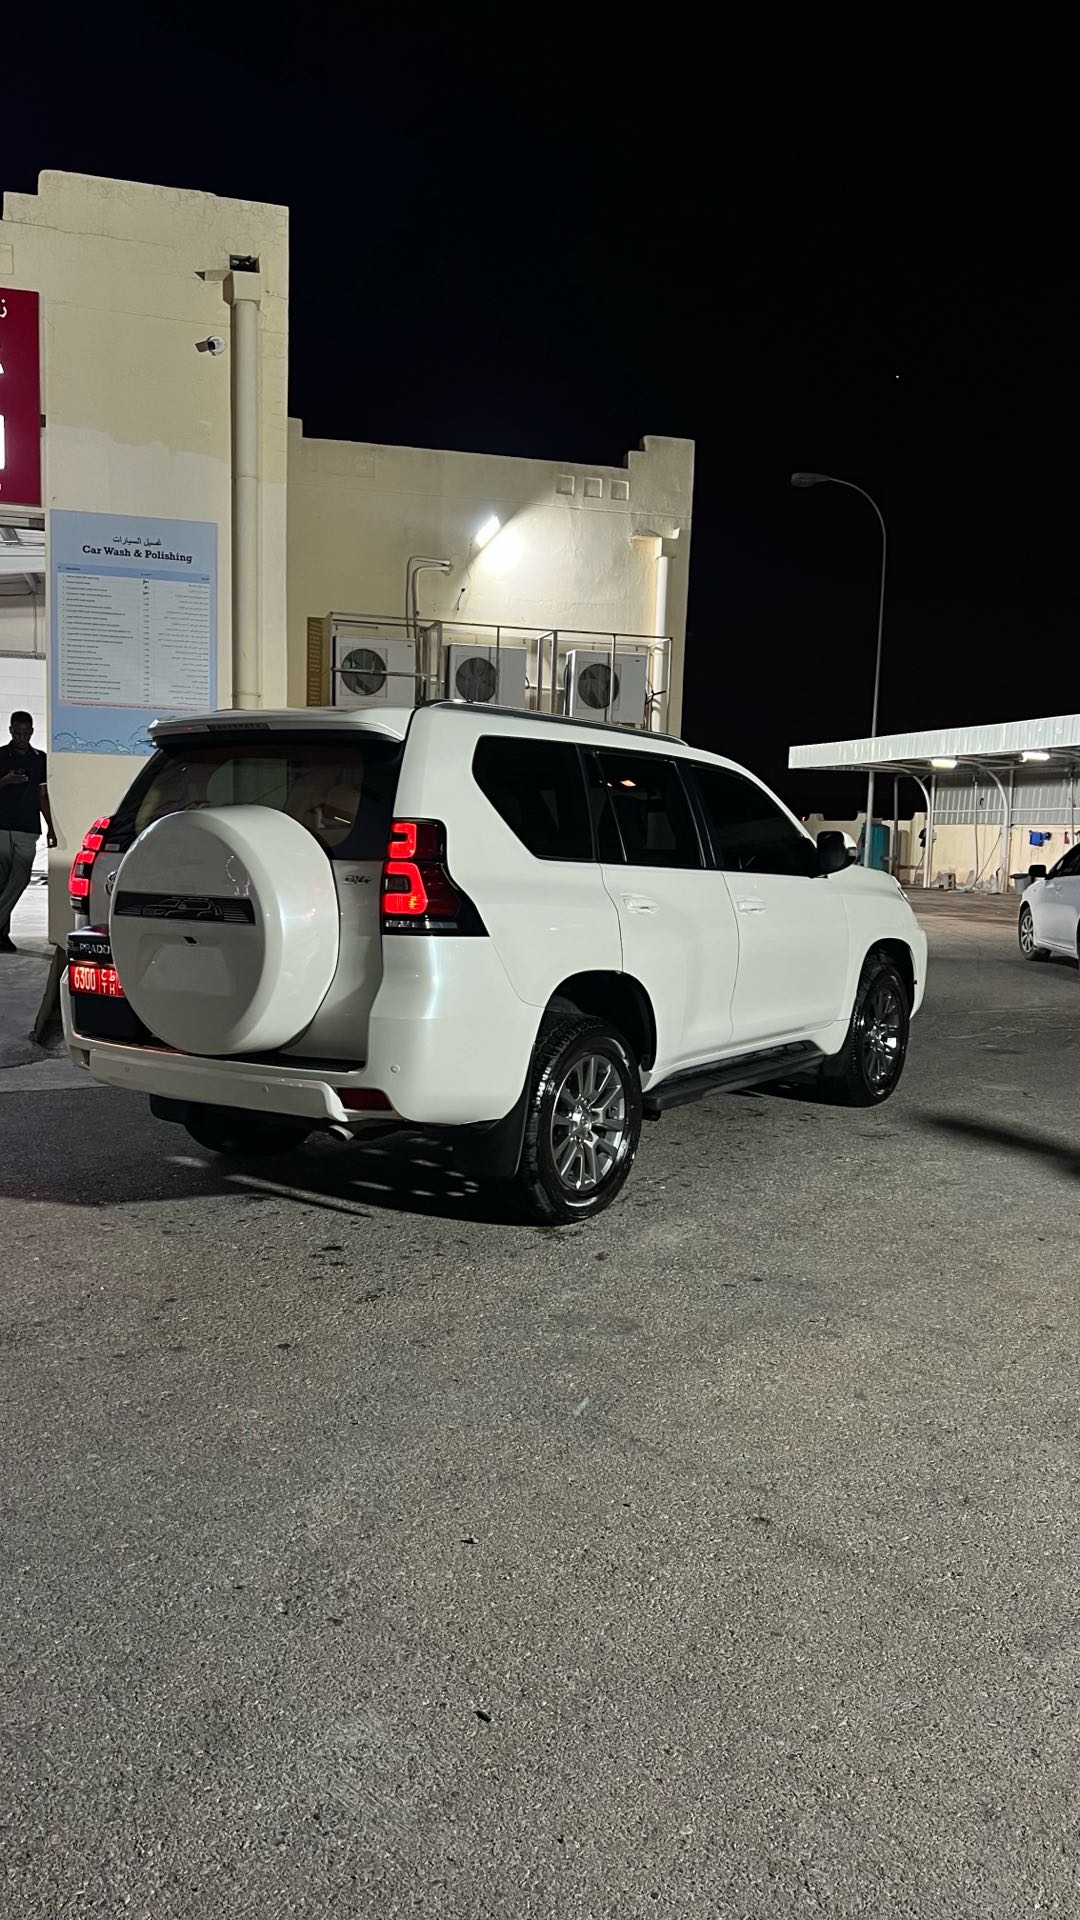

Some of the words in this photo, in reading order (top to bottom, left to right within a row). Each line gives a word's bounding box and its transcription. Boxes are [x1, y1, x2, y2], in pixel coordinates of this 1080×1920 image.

[112, 536, 142, 546] السيارات
[143, 538, 162, 547] غسيل
[82, 545, 102, 555] Car
[103, 546, 131, 557] Wash
[133, 549, 143, 558] &
[144, 550, 193, 564] Polishing
[79, 943, 111, 954] PRADO
[74, 966, 96, 991] 6300
